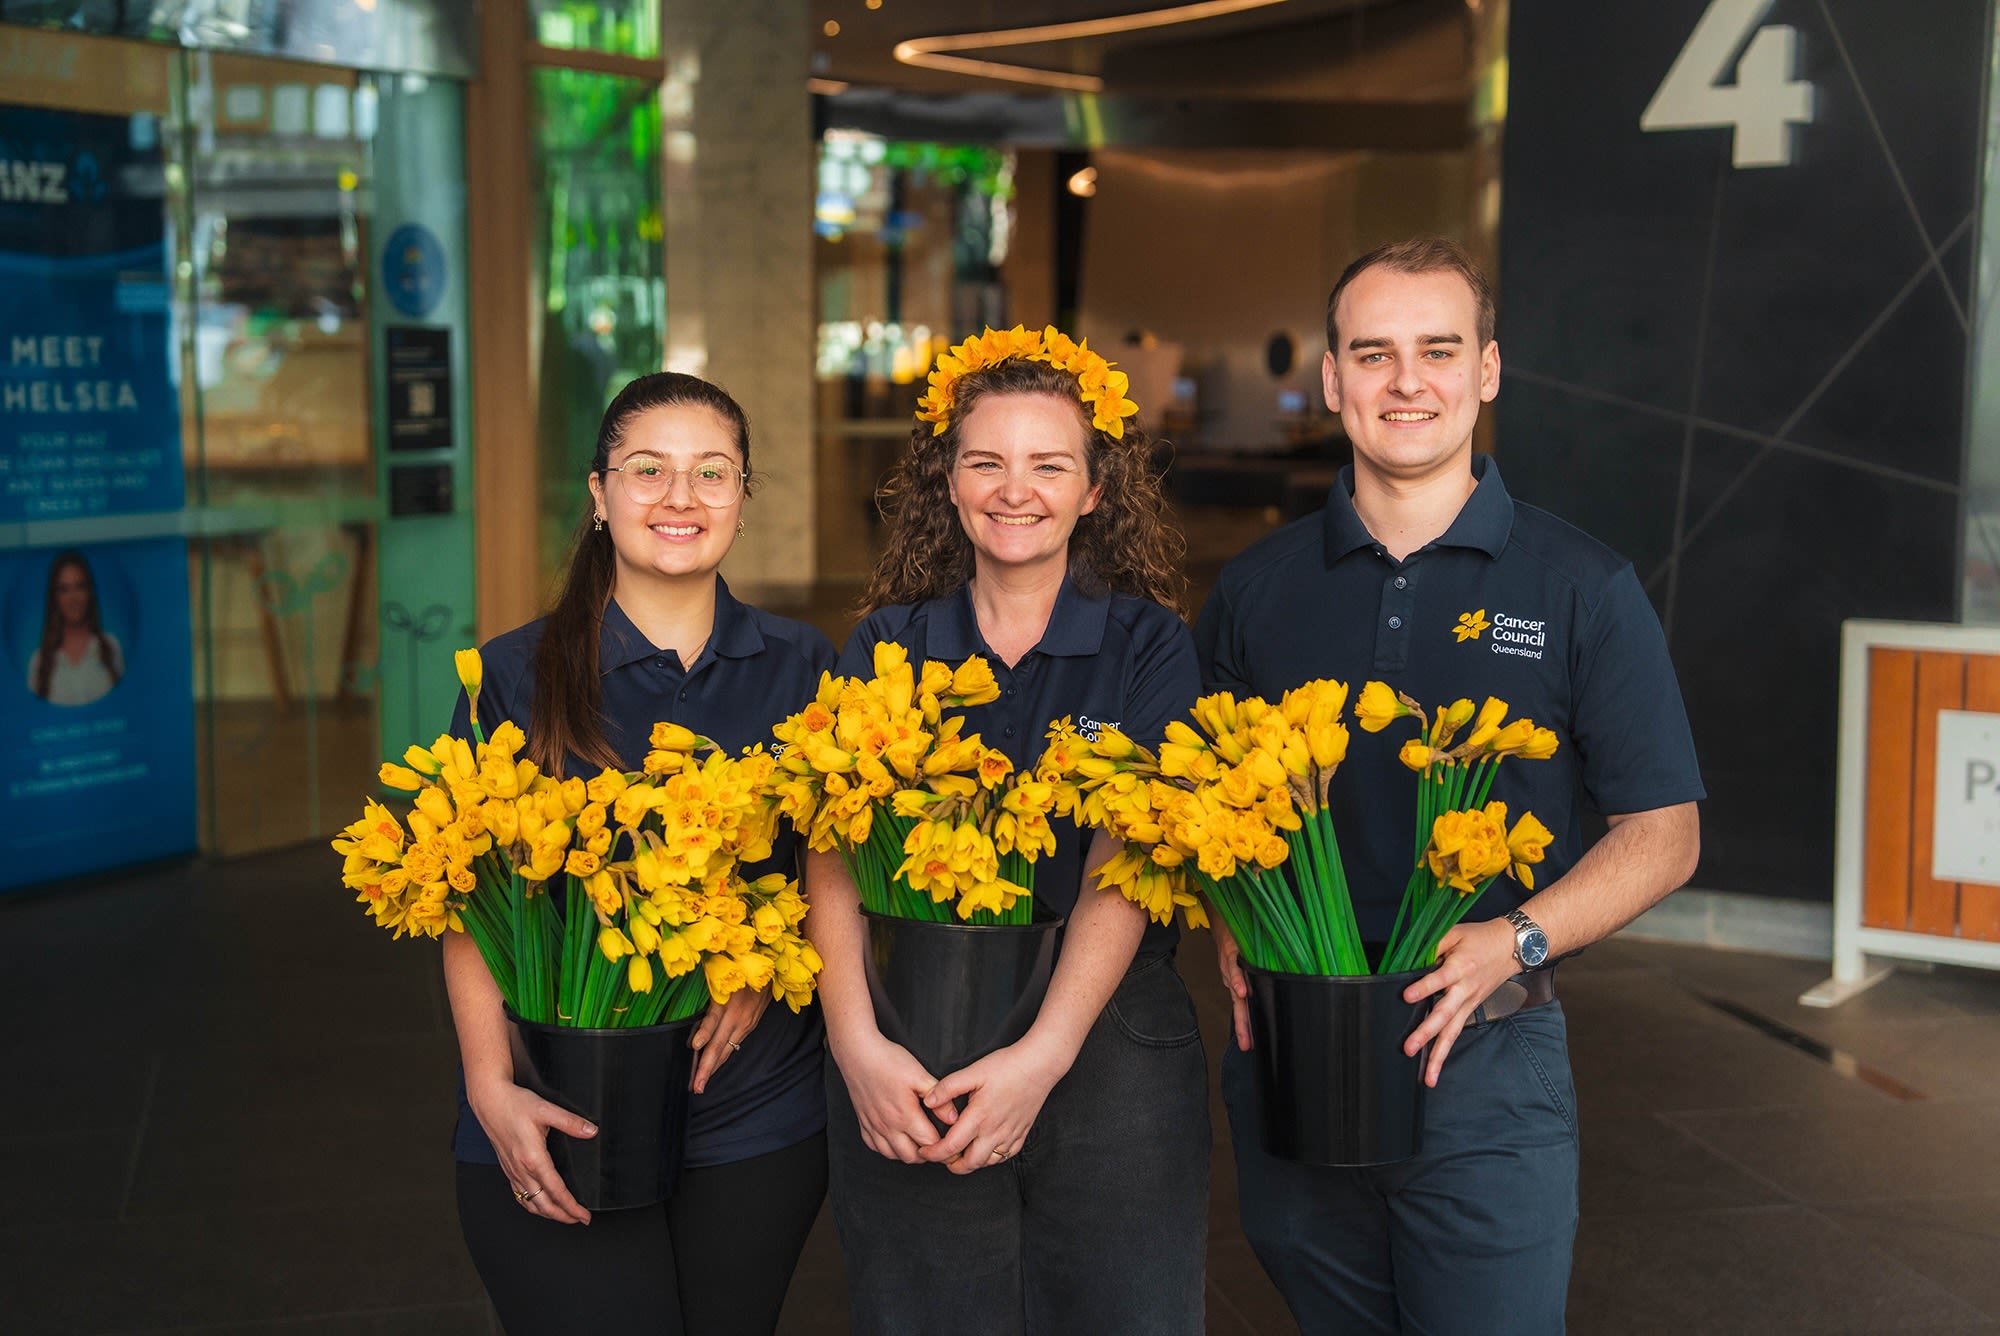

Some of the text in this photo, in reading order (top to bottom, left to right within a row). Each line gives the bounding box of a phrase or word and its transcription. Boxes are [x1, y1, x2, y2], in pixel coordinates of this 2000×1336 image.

[1640, 0, 1814, 169] 4
[11, 335, 103, 368] MEET
[0, 380, 138, 412] HELSEA
[1494, 613, 1545, 631] Cancer
[1492, 627, 1545, 646] Council
[1492, 643, 1542, 659] Queensland
[1079, 729, 1101, 742] Cou
[1966, 758, 2000, 803] P
